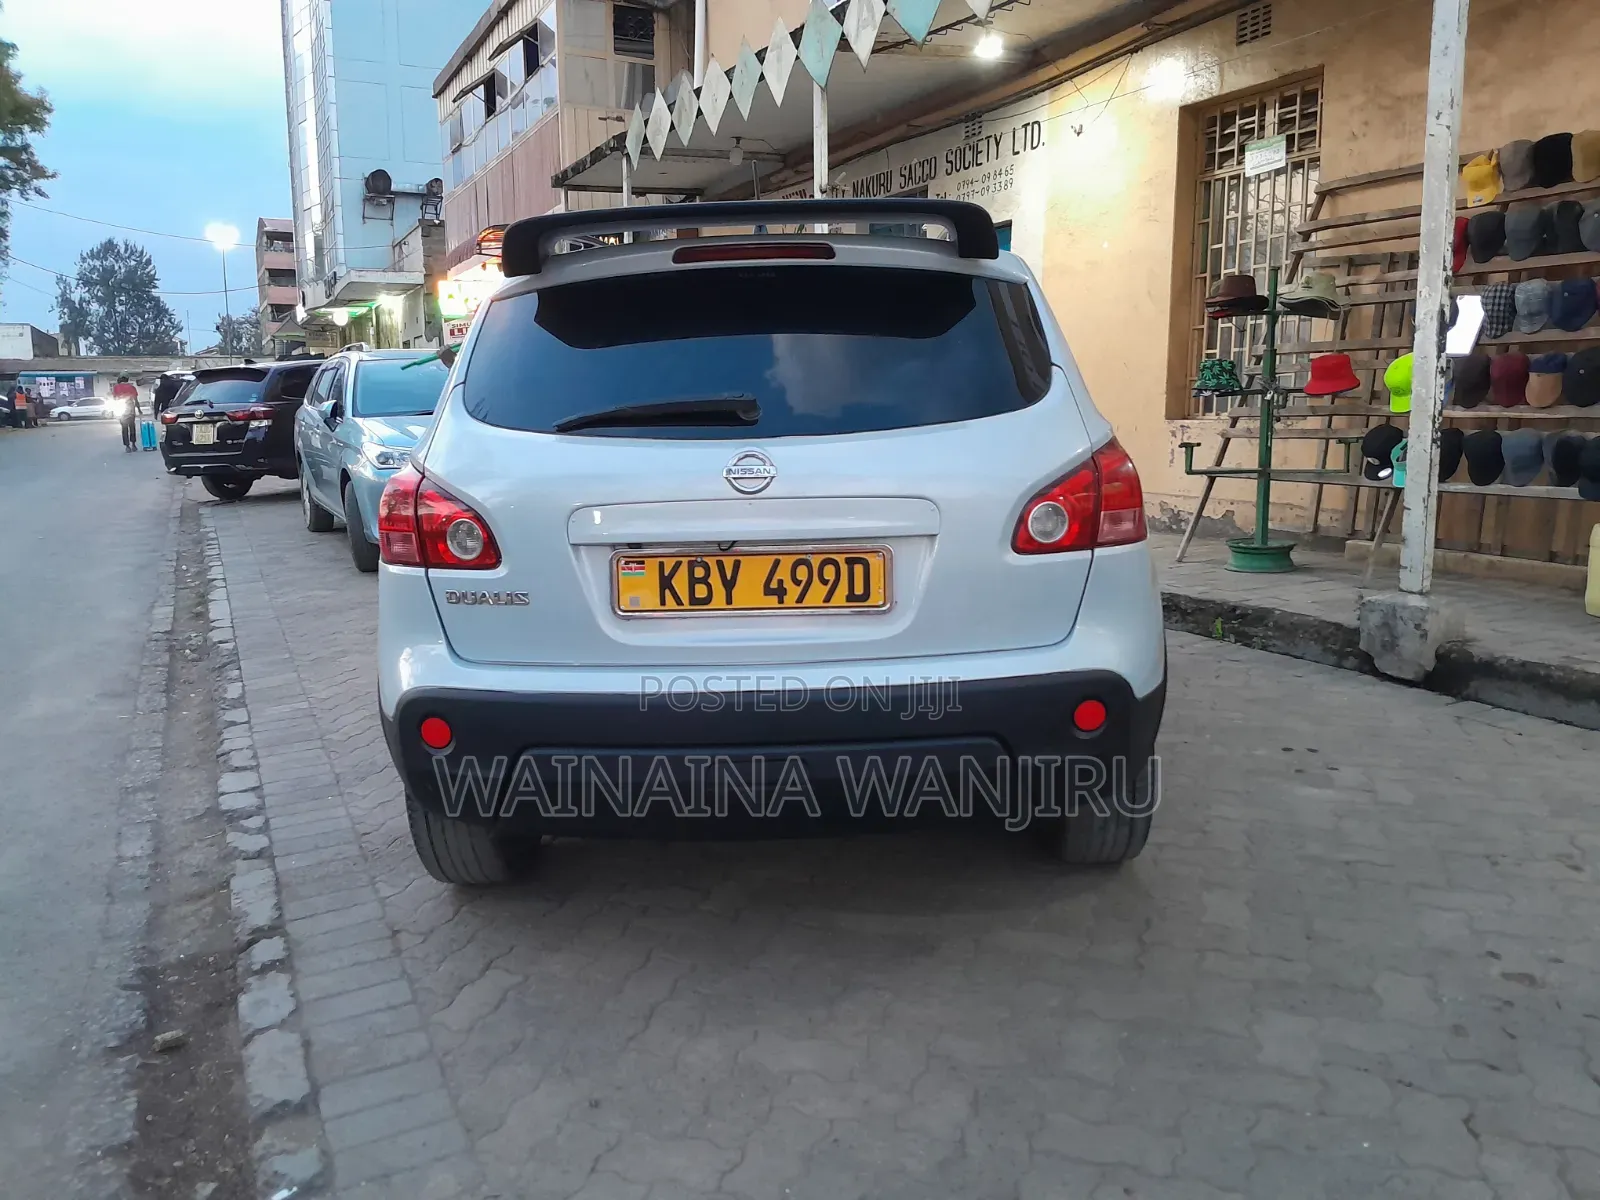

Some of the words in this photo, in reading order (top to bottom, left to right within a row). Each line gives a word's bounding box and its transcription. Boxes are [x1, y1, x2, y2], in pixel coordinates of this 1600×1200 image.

[852, 169, 894, 199] NAKURU
[899, 156, 938, 190] SACCO
[945, 132, 1004, 176] SOCIETY
[1011, 120, 1046, 156] LTD.
[728, 467, 771, 475] NISSAN
[445, 589, 530, 606] DUALIS
[658, 558, 742, 606] KBY
[762, 556, 872, 605] 499D
